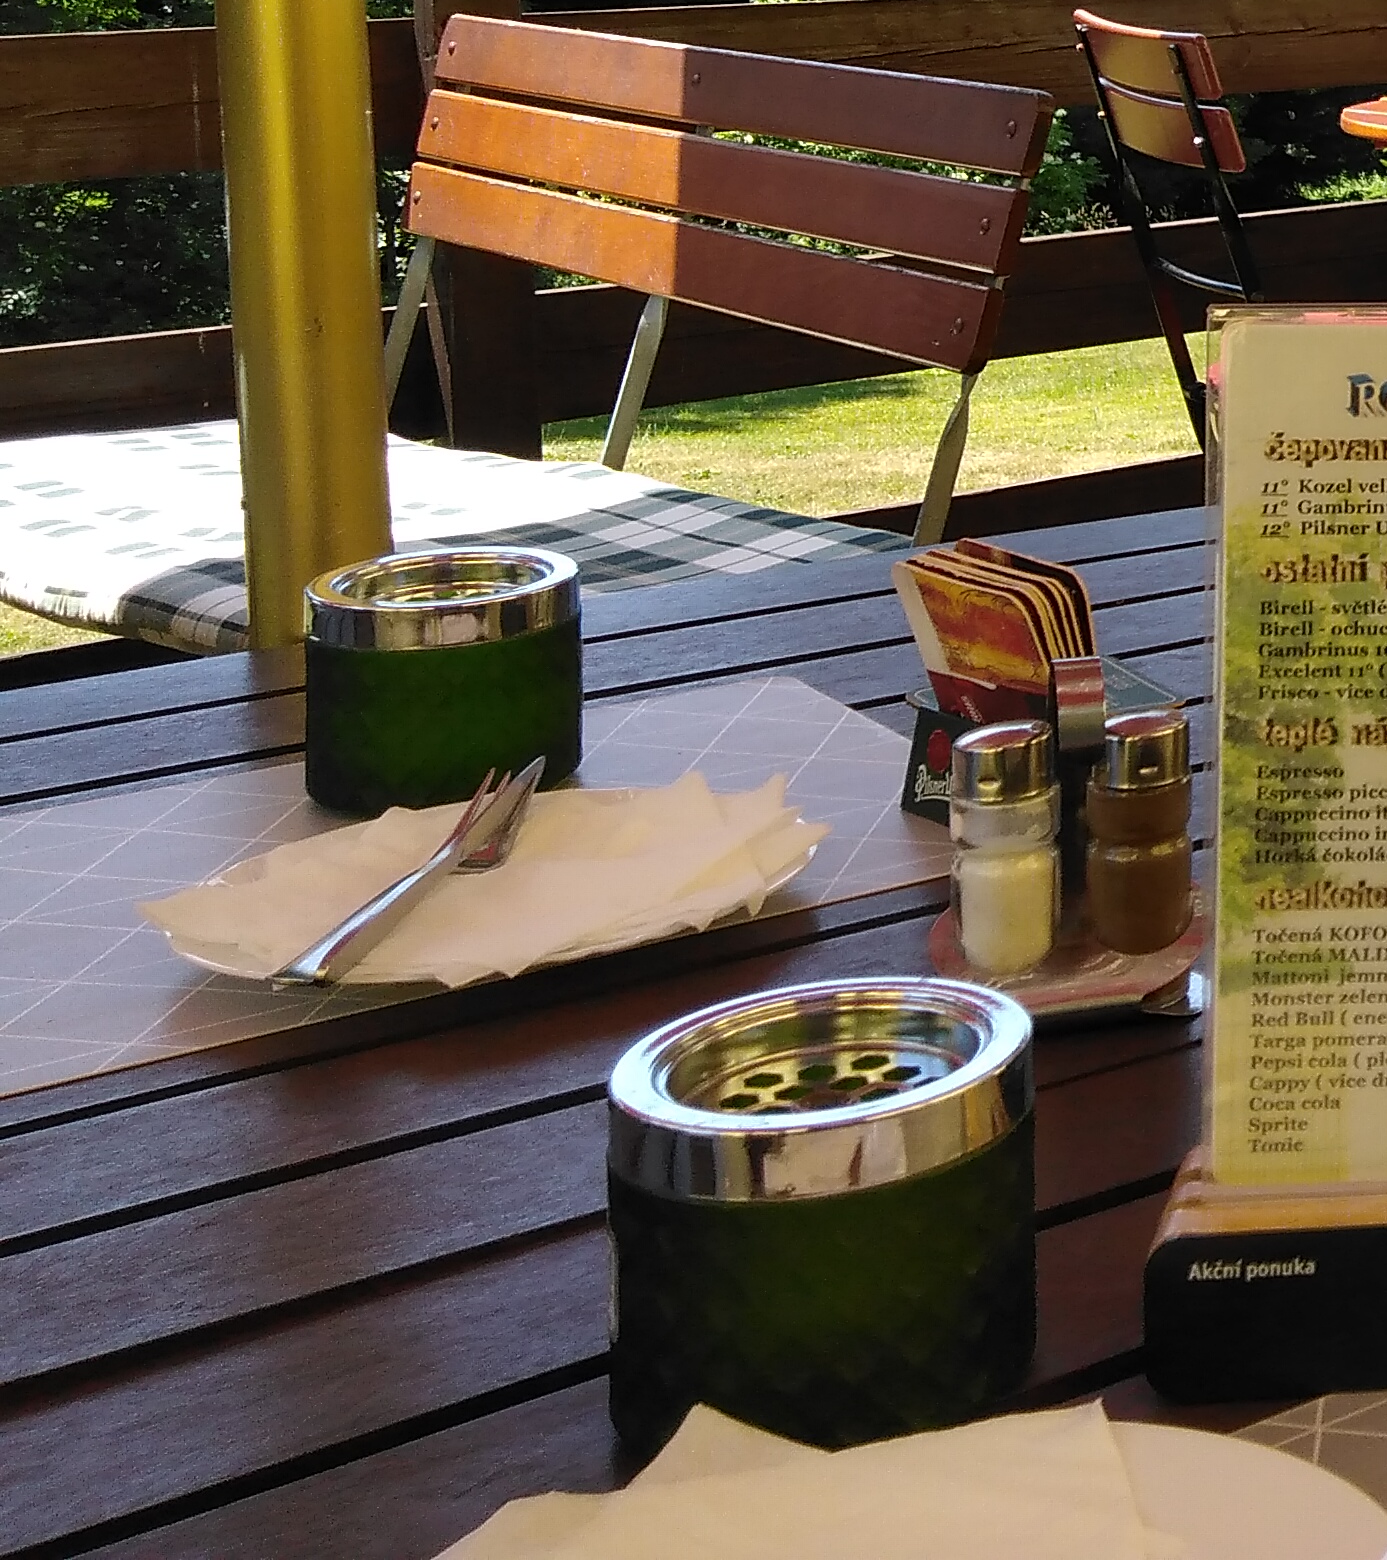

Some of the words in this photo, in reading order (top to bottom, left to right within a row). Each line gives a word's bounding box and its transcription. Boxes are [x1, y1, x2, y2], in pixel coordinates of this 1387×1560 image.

[1298, 478, 1353, 494] Kozel
[1300, 520, 1370, 536] Pilsner
[1260, 600, 1314, 616] Birell
[1332, 599, 1387, 615] světlé
[1260, 620, 1314, 636] Birell
[1258, 642, 1369, 658] Gambrinus
[1258, 664, 1342, 679] Excelent
[1258, 684, 1318, 700] Frisco
[1336, 684, 1374, 700] více
[1256, 764, 1344, 781] Espresso
[1256, 786, 1344, 802] Espresso
[1254, 805, 1370, 824] Cappuccino
[1254, 826, 1370, 845] Cappuccino
[1255, 846, 1316, 864] Horká
[1252, 927, 1322, 944] Točená
[1252, 949, 1322, 966] Točená
[1252, 970, 1330, 986] Mattoni
[1252, 992, 1334, 1008] Monster
[1251, 1012, 1288, 1028] Red
[1295, 1011, 1334, 1026] Bull
[1251, 1034, 1306, 1052] Targa
[1251, 1054, 1302, 1073] Pepsi
[1308, 1052, 1348, 1068] cola
[1250, 1076, 1310, 1093] Cappy
[1329, 1073, 1366, 1088] více
[1249, 1096, 1295, 1112] Coca
[1302, 1094, 1341, 1110] cola
[1248, 1117, 1308, 1136] Sprite
[1250, 1138, 1304, 1154] Tonic
[1187, 1259, 1242, 1282] Akční
[1245, 1256, 1316, 1278] ponuka
